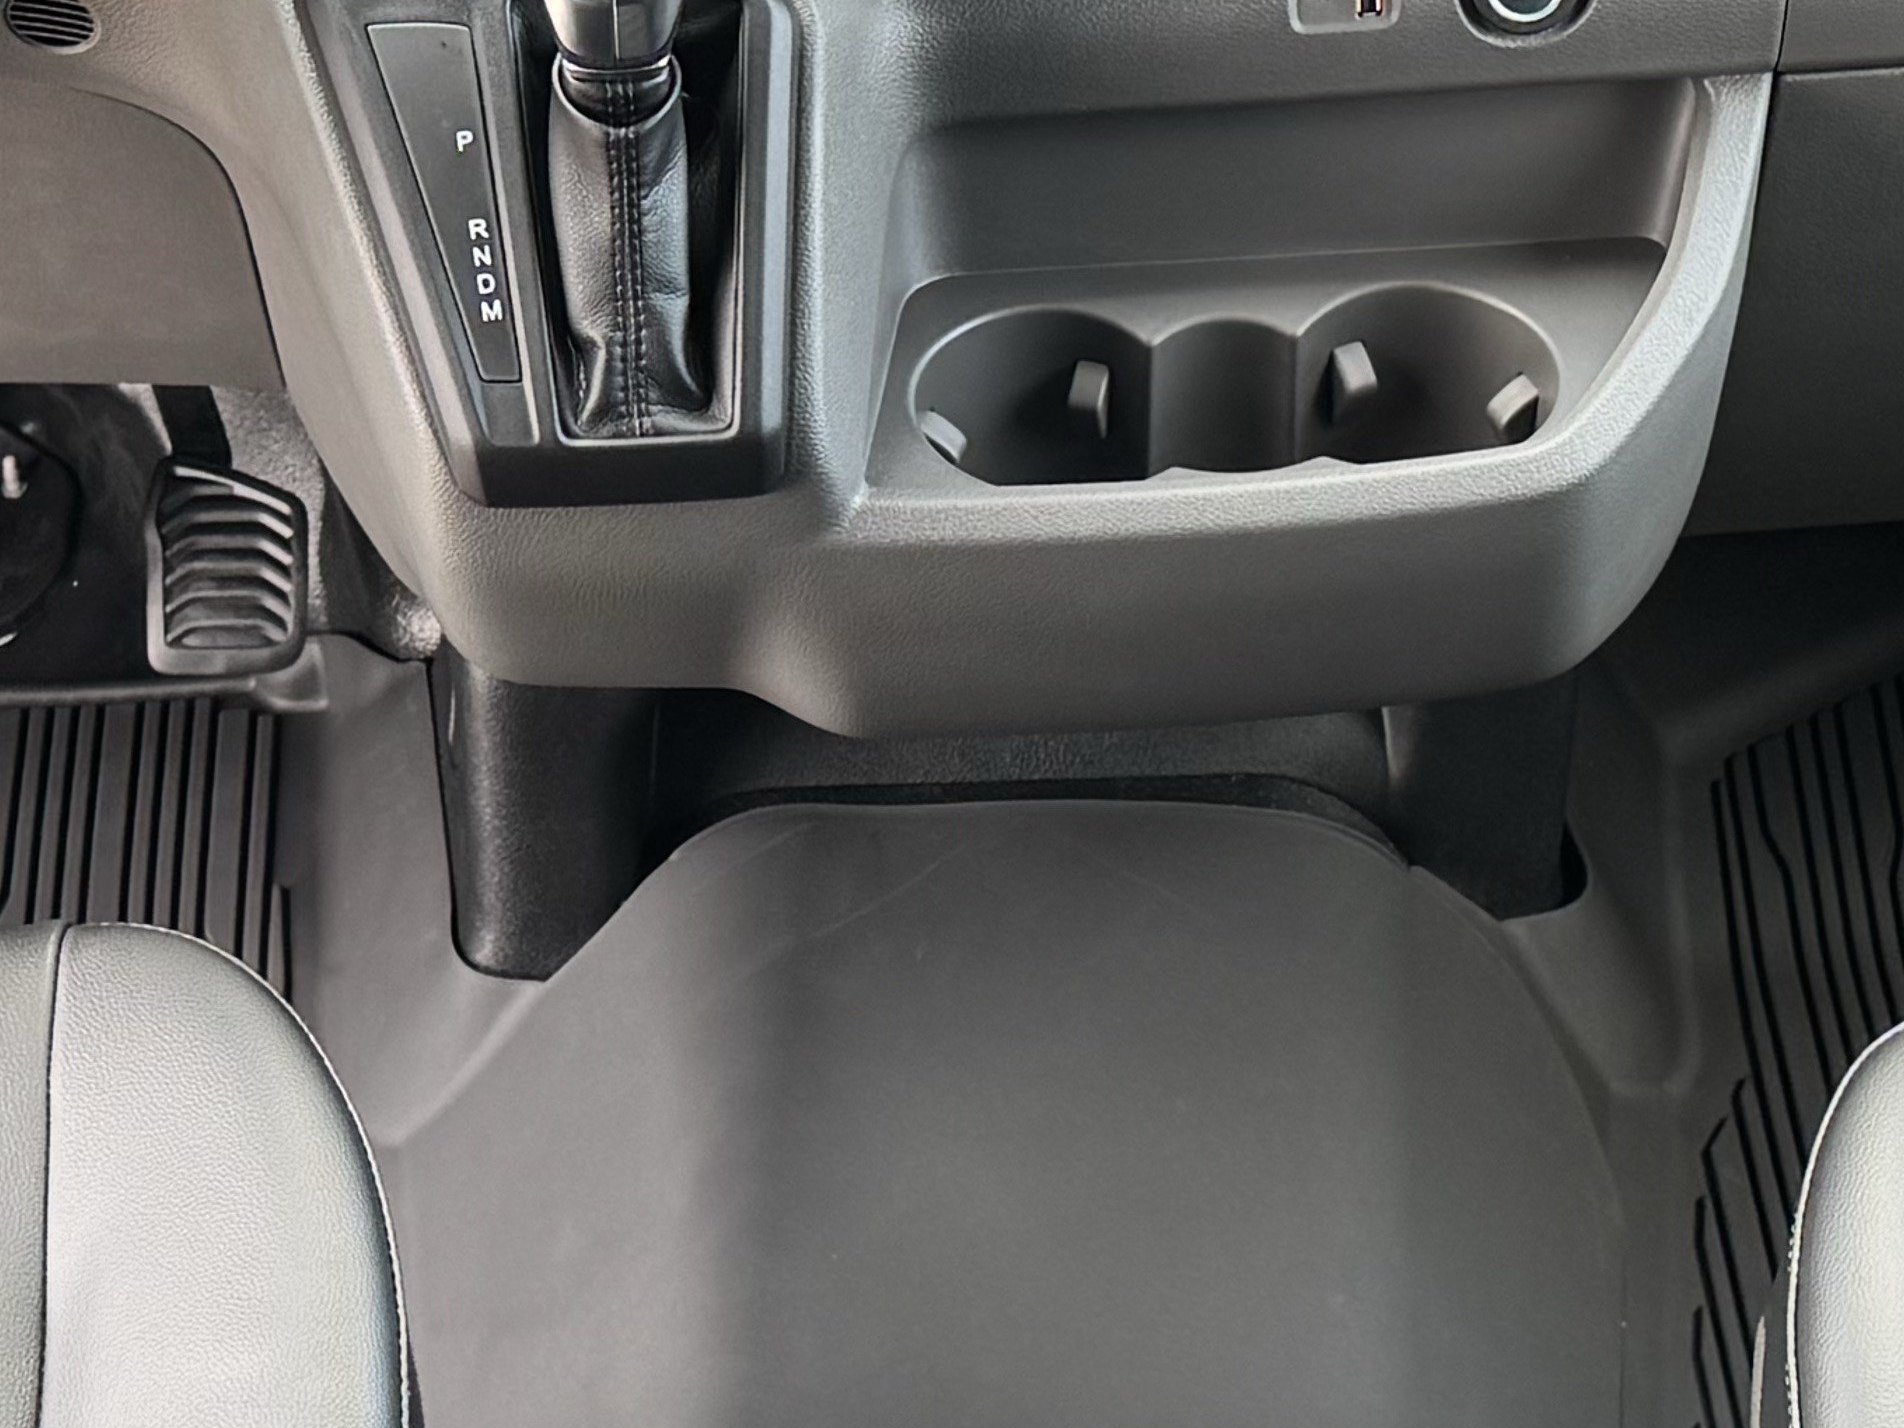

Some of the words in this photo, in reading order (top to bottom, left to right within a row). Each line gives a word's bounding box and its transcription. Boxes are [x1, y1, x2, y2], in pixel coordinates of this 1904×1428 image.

[455, 130, 474, 153] P
[468, 218, 489, 240] R
[472, 247, 492, 267] N
[477, 273, 496, 295] D
[481, 300, 504, 323] M
